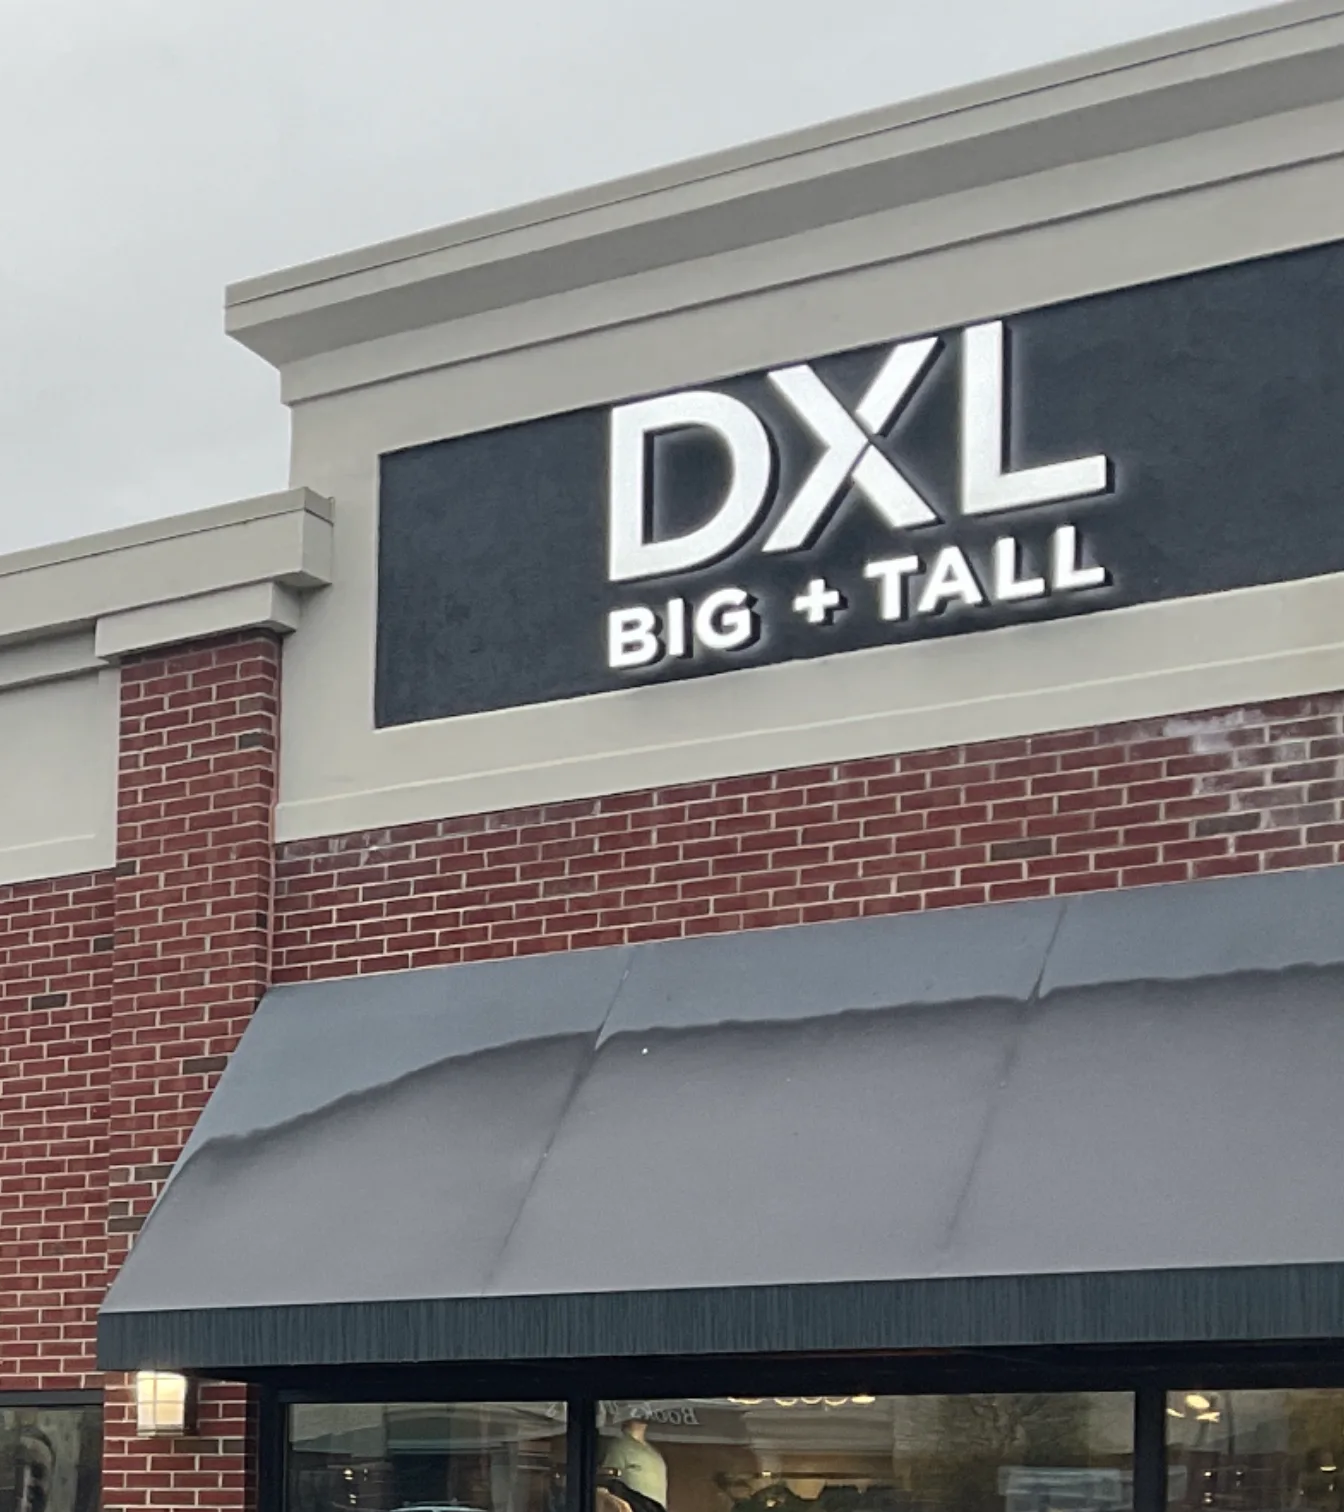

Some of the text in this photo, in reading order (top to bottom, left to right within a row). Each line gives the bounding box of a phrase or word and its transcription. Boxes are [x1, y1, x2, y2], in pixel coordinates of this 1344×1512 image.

[608, 320, 1113, 582] DXL
[608, 525, 1113, 668] BIG + TALL
